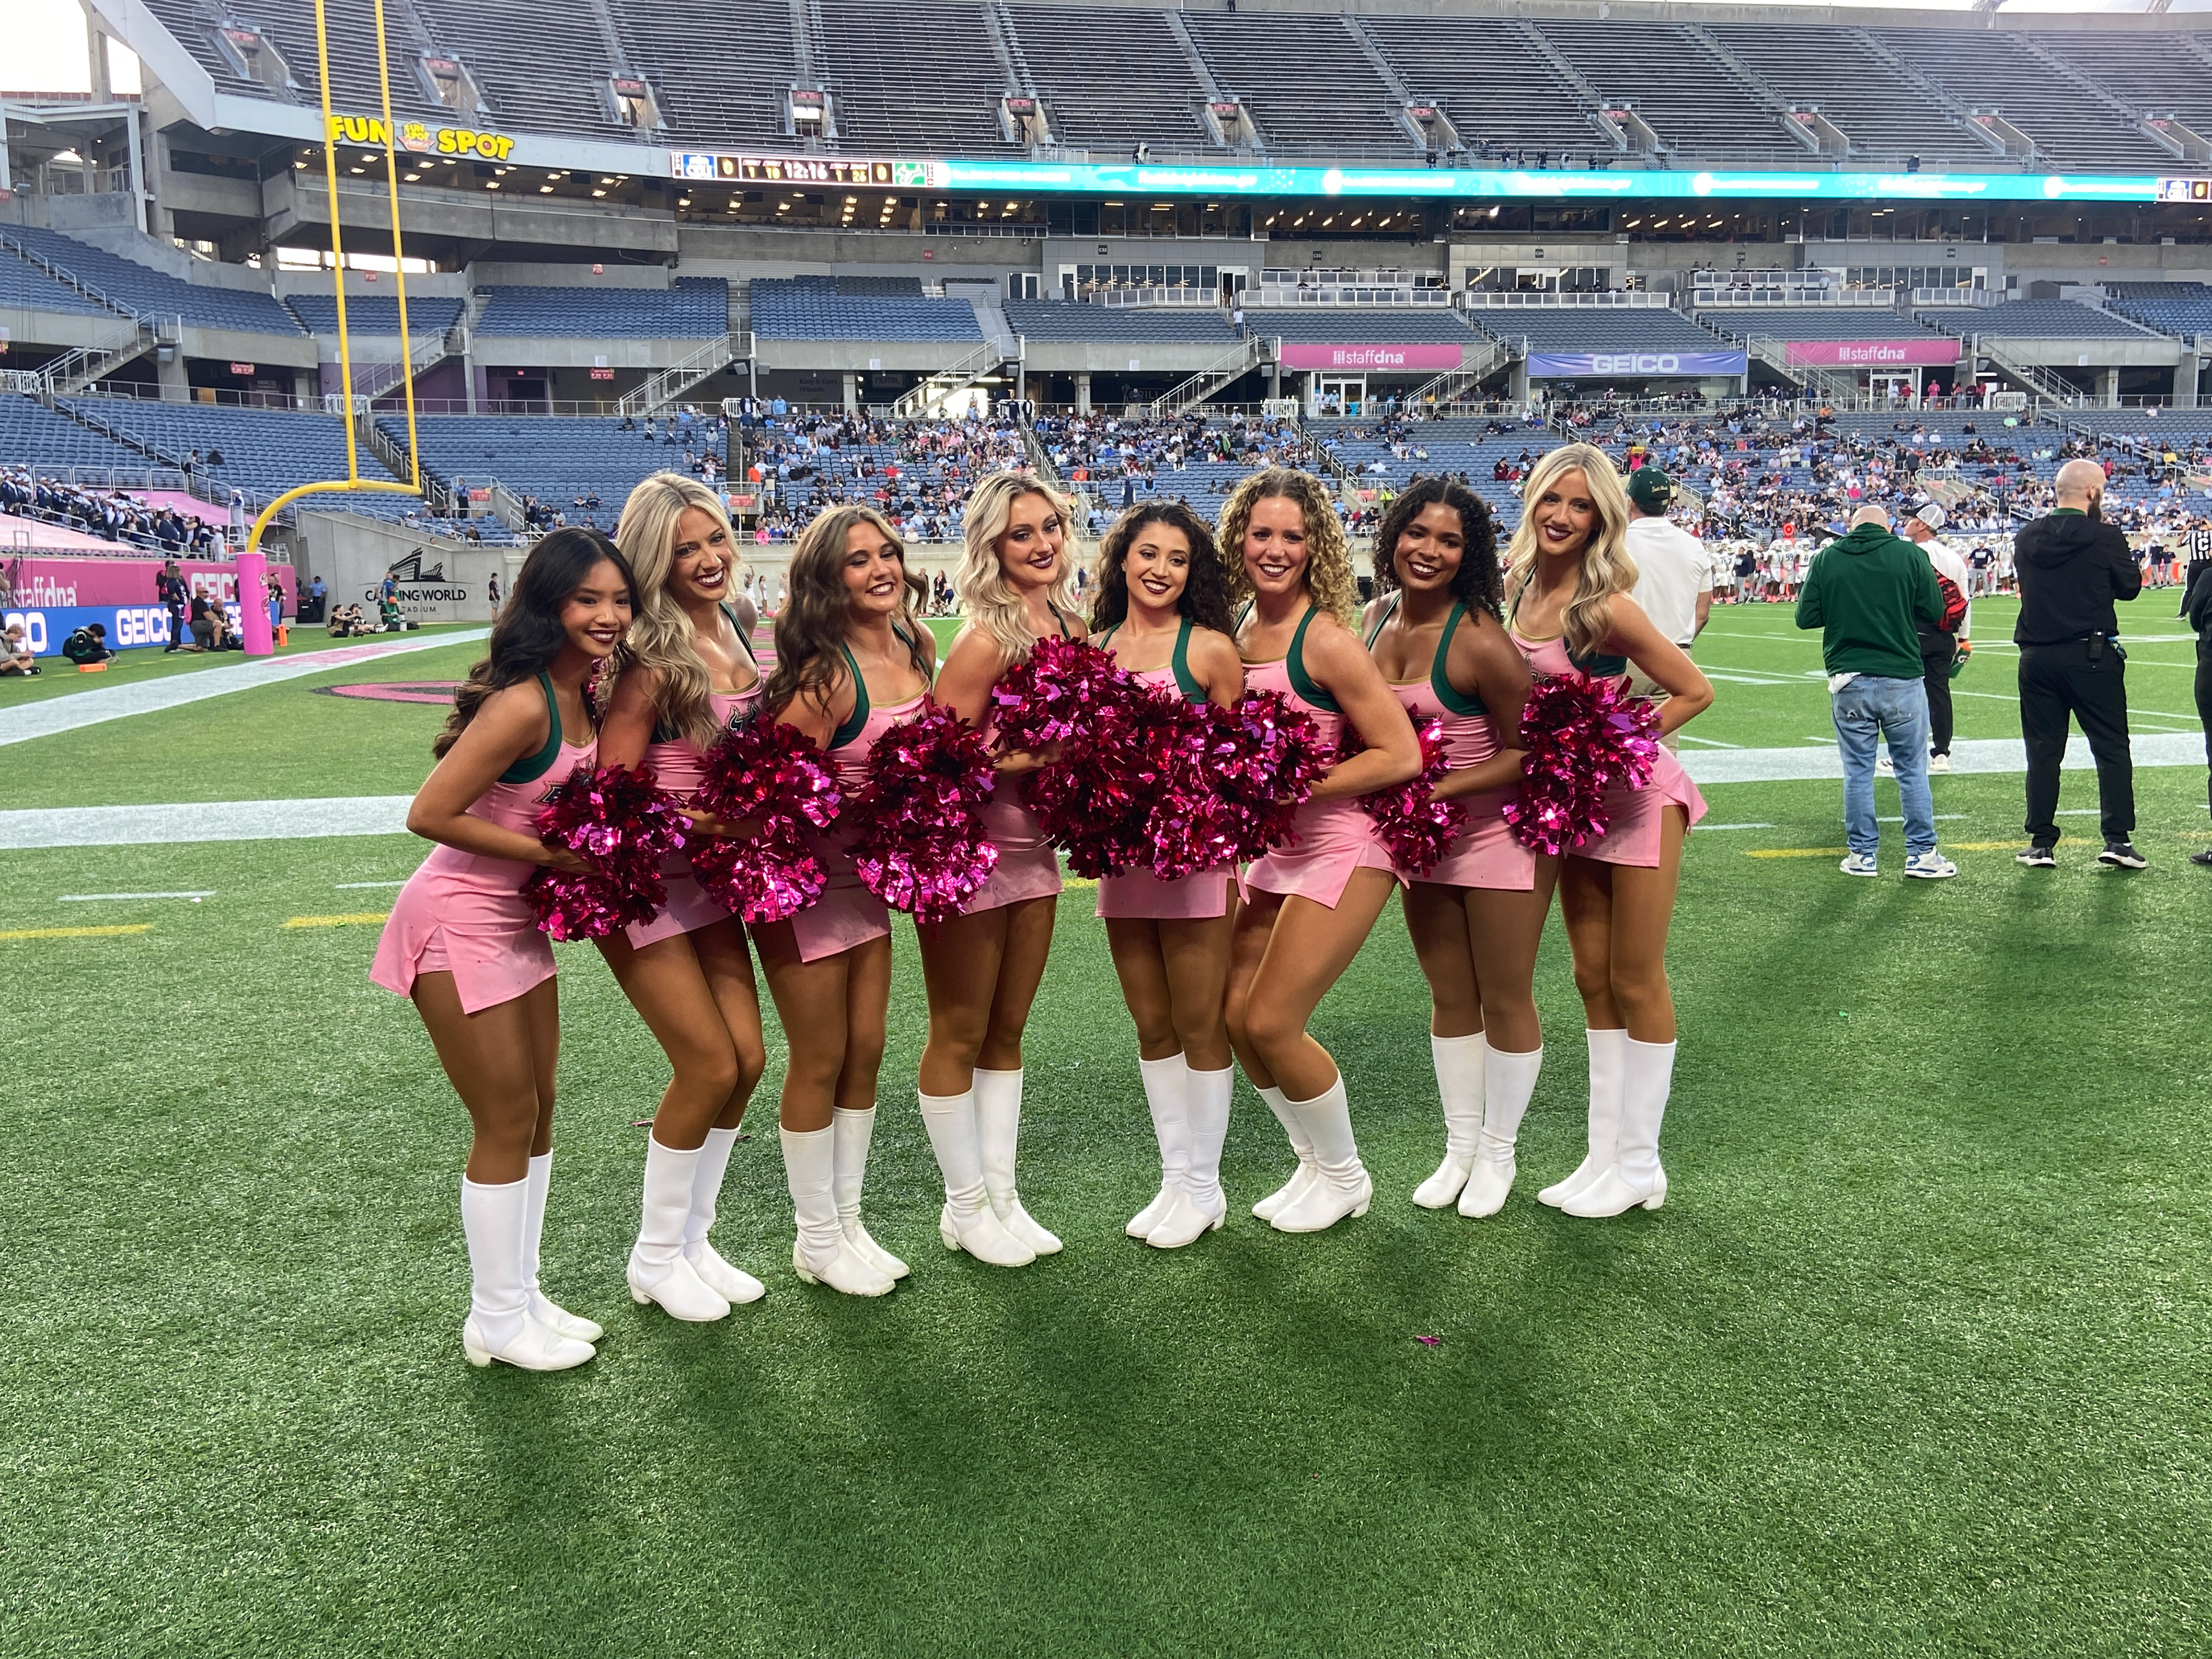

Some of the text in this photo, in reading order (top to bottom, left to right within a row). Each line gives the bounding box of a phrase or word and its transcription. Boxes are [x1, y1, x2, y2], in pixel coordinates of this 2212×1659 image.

[404, 123, 425, 133] FUN
[331, 115, 515, 161] FUN SPOT
[406, 131, 431, 141] SPOT
[722, 157, 733, 175] 0
[748, 165, 756, 179] 1
[765, 166, 781, 179] 10
[783, 160, 828, 180] 12:16
[835, 168, 843, 182] 1
[851, 169, 867, 182] 26
[876, 163, 887, 181] 0
[2195, 183, 2205, 198] 0
[1346, 350, 1404, 364] staffdna
[1851, 346, 1906, 360] staffdna
[1592, 355, 1679, 373] GEICO
[2198, 537, 2209, 551] C
[1786, 553, 1794, 561] 99
[1804, 555, 1809, 563] 8
[13, 576, 77, 608] staffdna
[191, 573, 237, 603] GEIC
[366, 590, 466, 601] CING WORLD
[116, 608, 172, 646] GEICO
[1958, 655, 1968, 664] G
